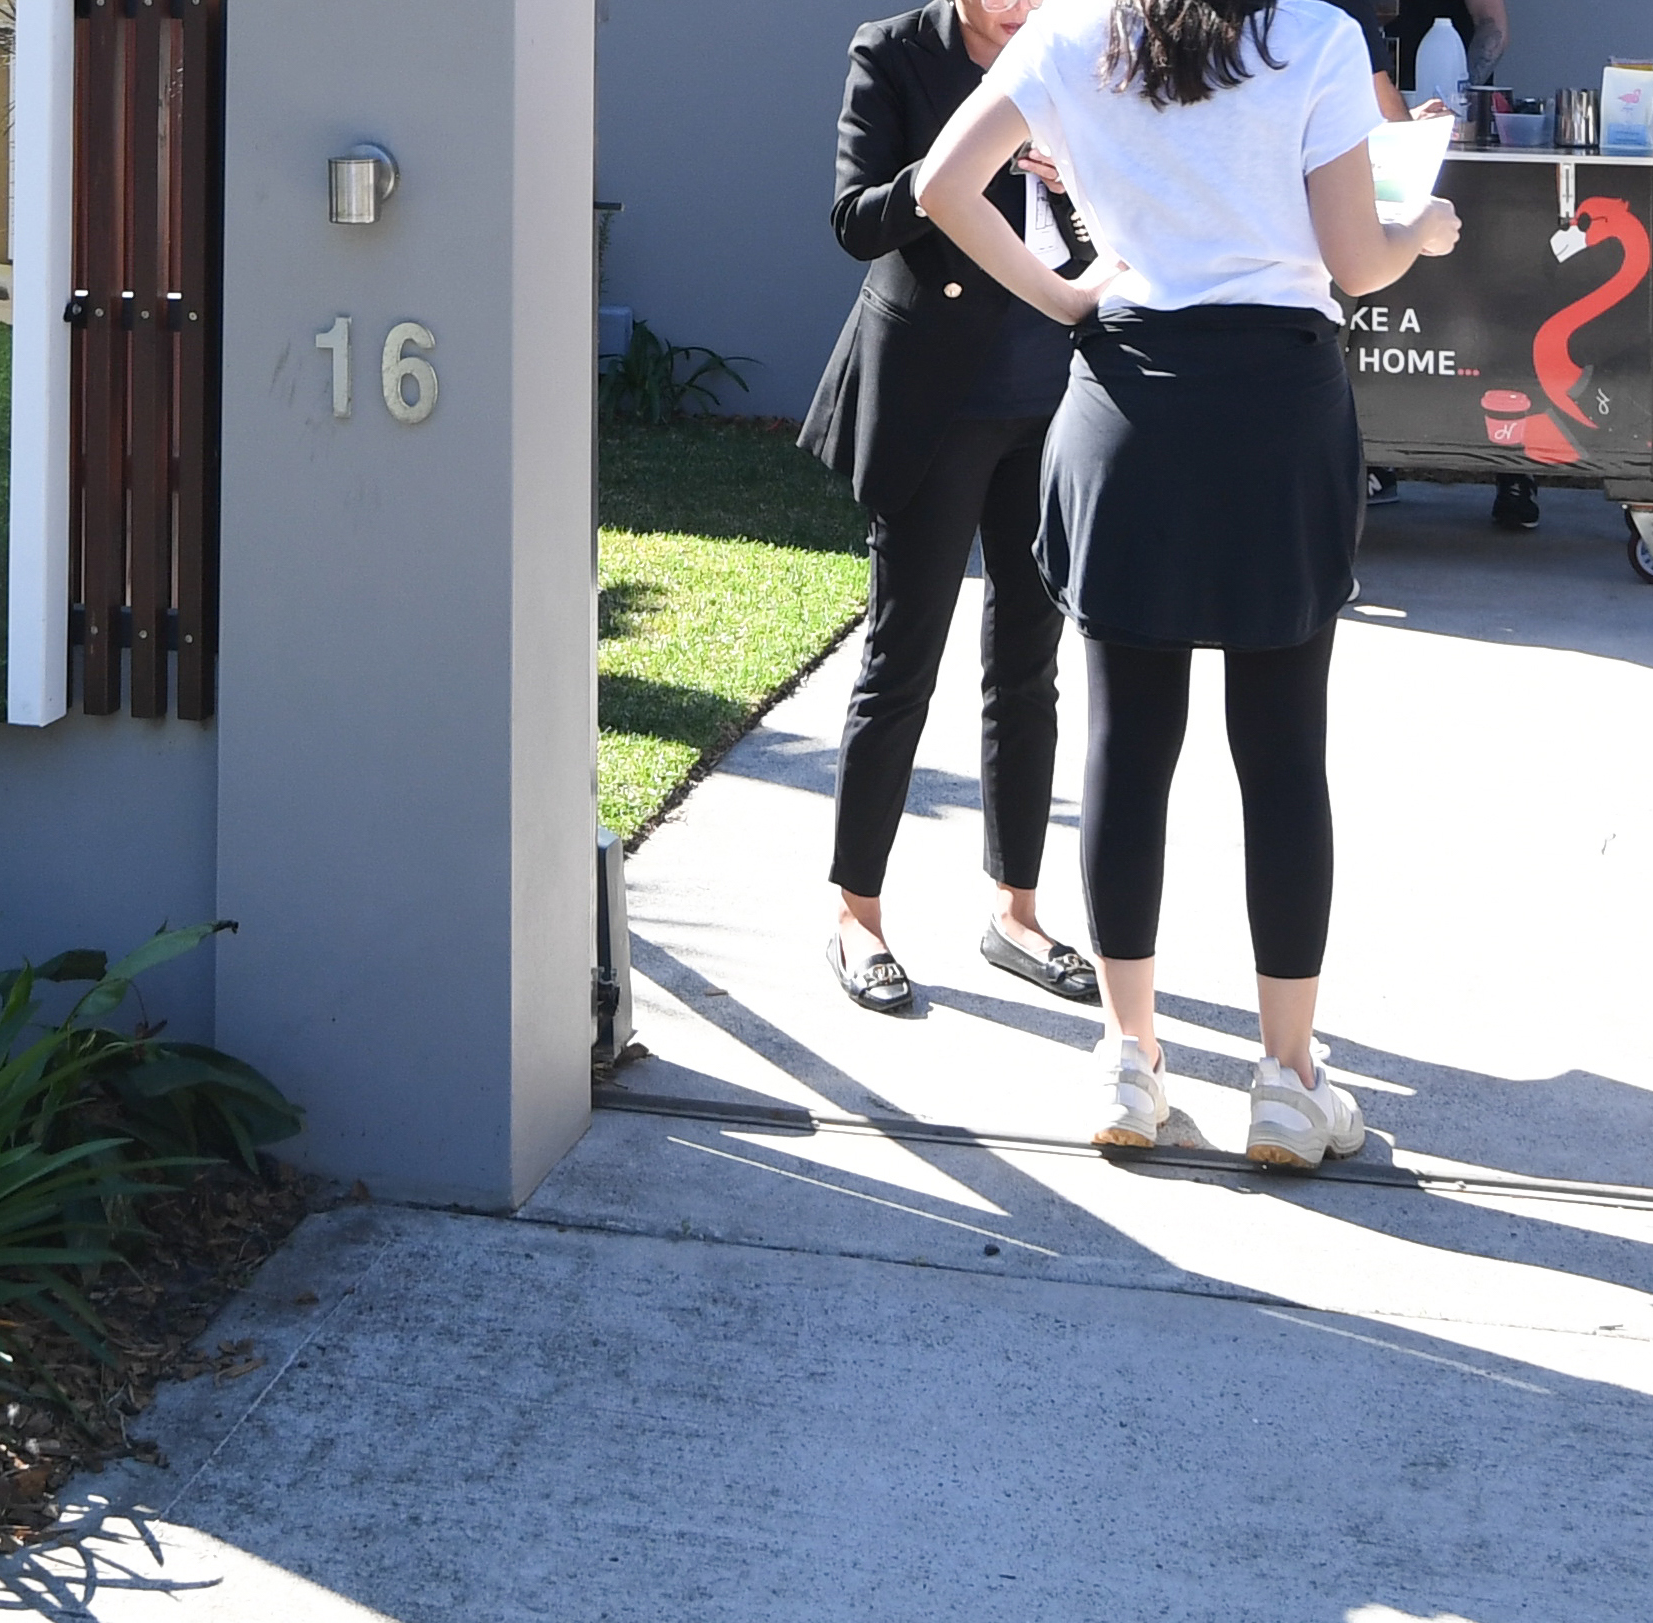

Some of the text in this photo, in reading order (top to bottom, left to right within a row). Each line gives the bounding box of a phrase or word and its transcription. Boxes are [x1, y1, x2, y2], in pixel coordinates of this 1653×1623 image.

[1349, 306, 1422, 334] KE A
[315, 316, 439, 425] 16
